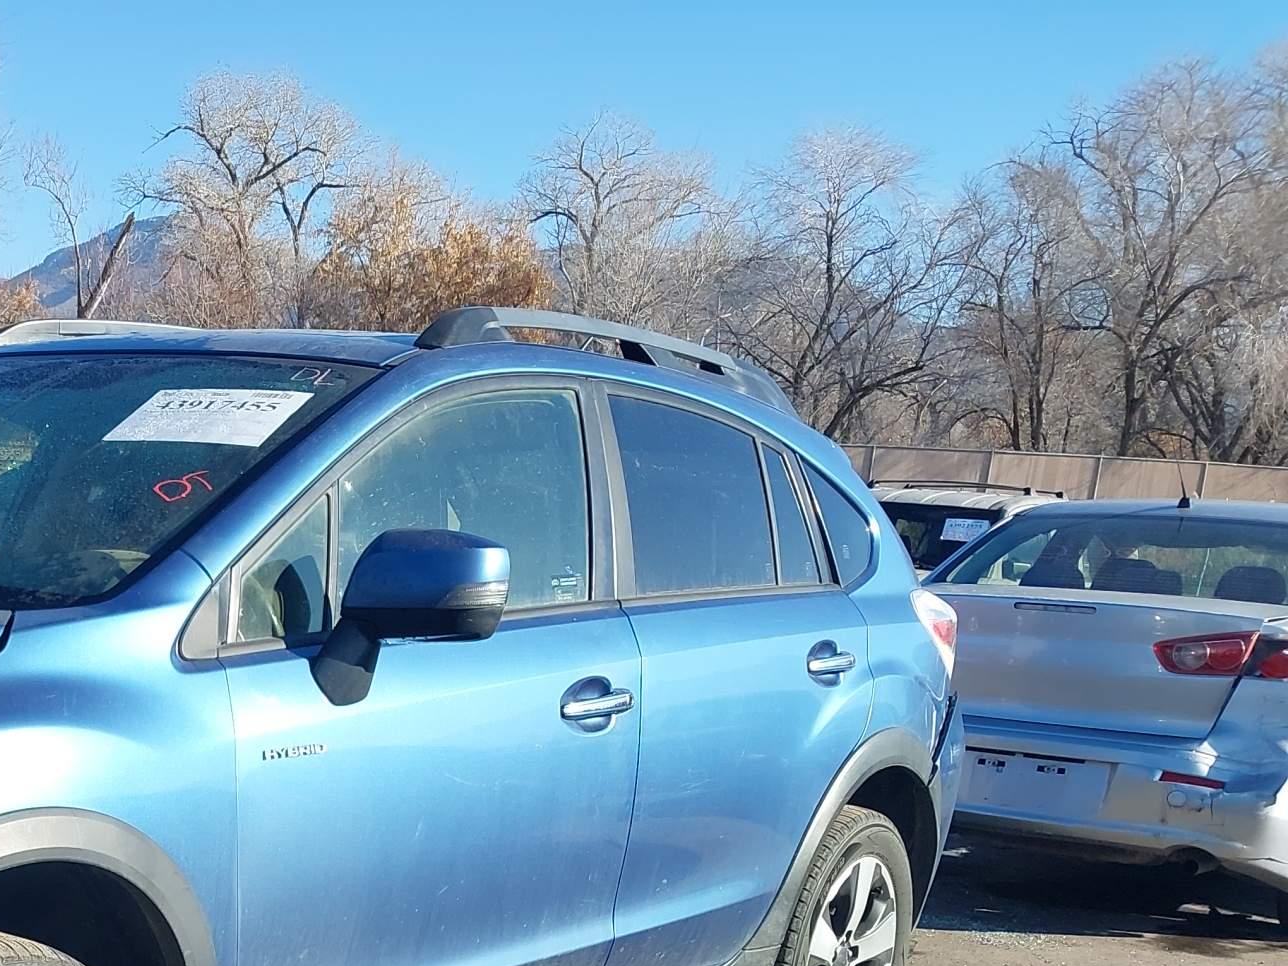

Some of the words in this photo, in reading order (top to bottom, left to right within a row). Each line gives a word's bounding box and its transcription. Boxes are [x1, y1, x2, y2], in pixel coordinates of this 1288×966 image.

[290, 366, 335, 386] DL
[155, 399, 281, 412] 43917455
[261, 743, 328, 761] HYBRID
